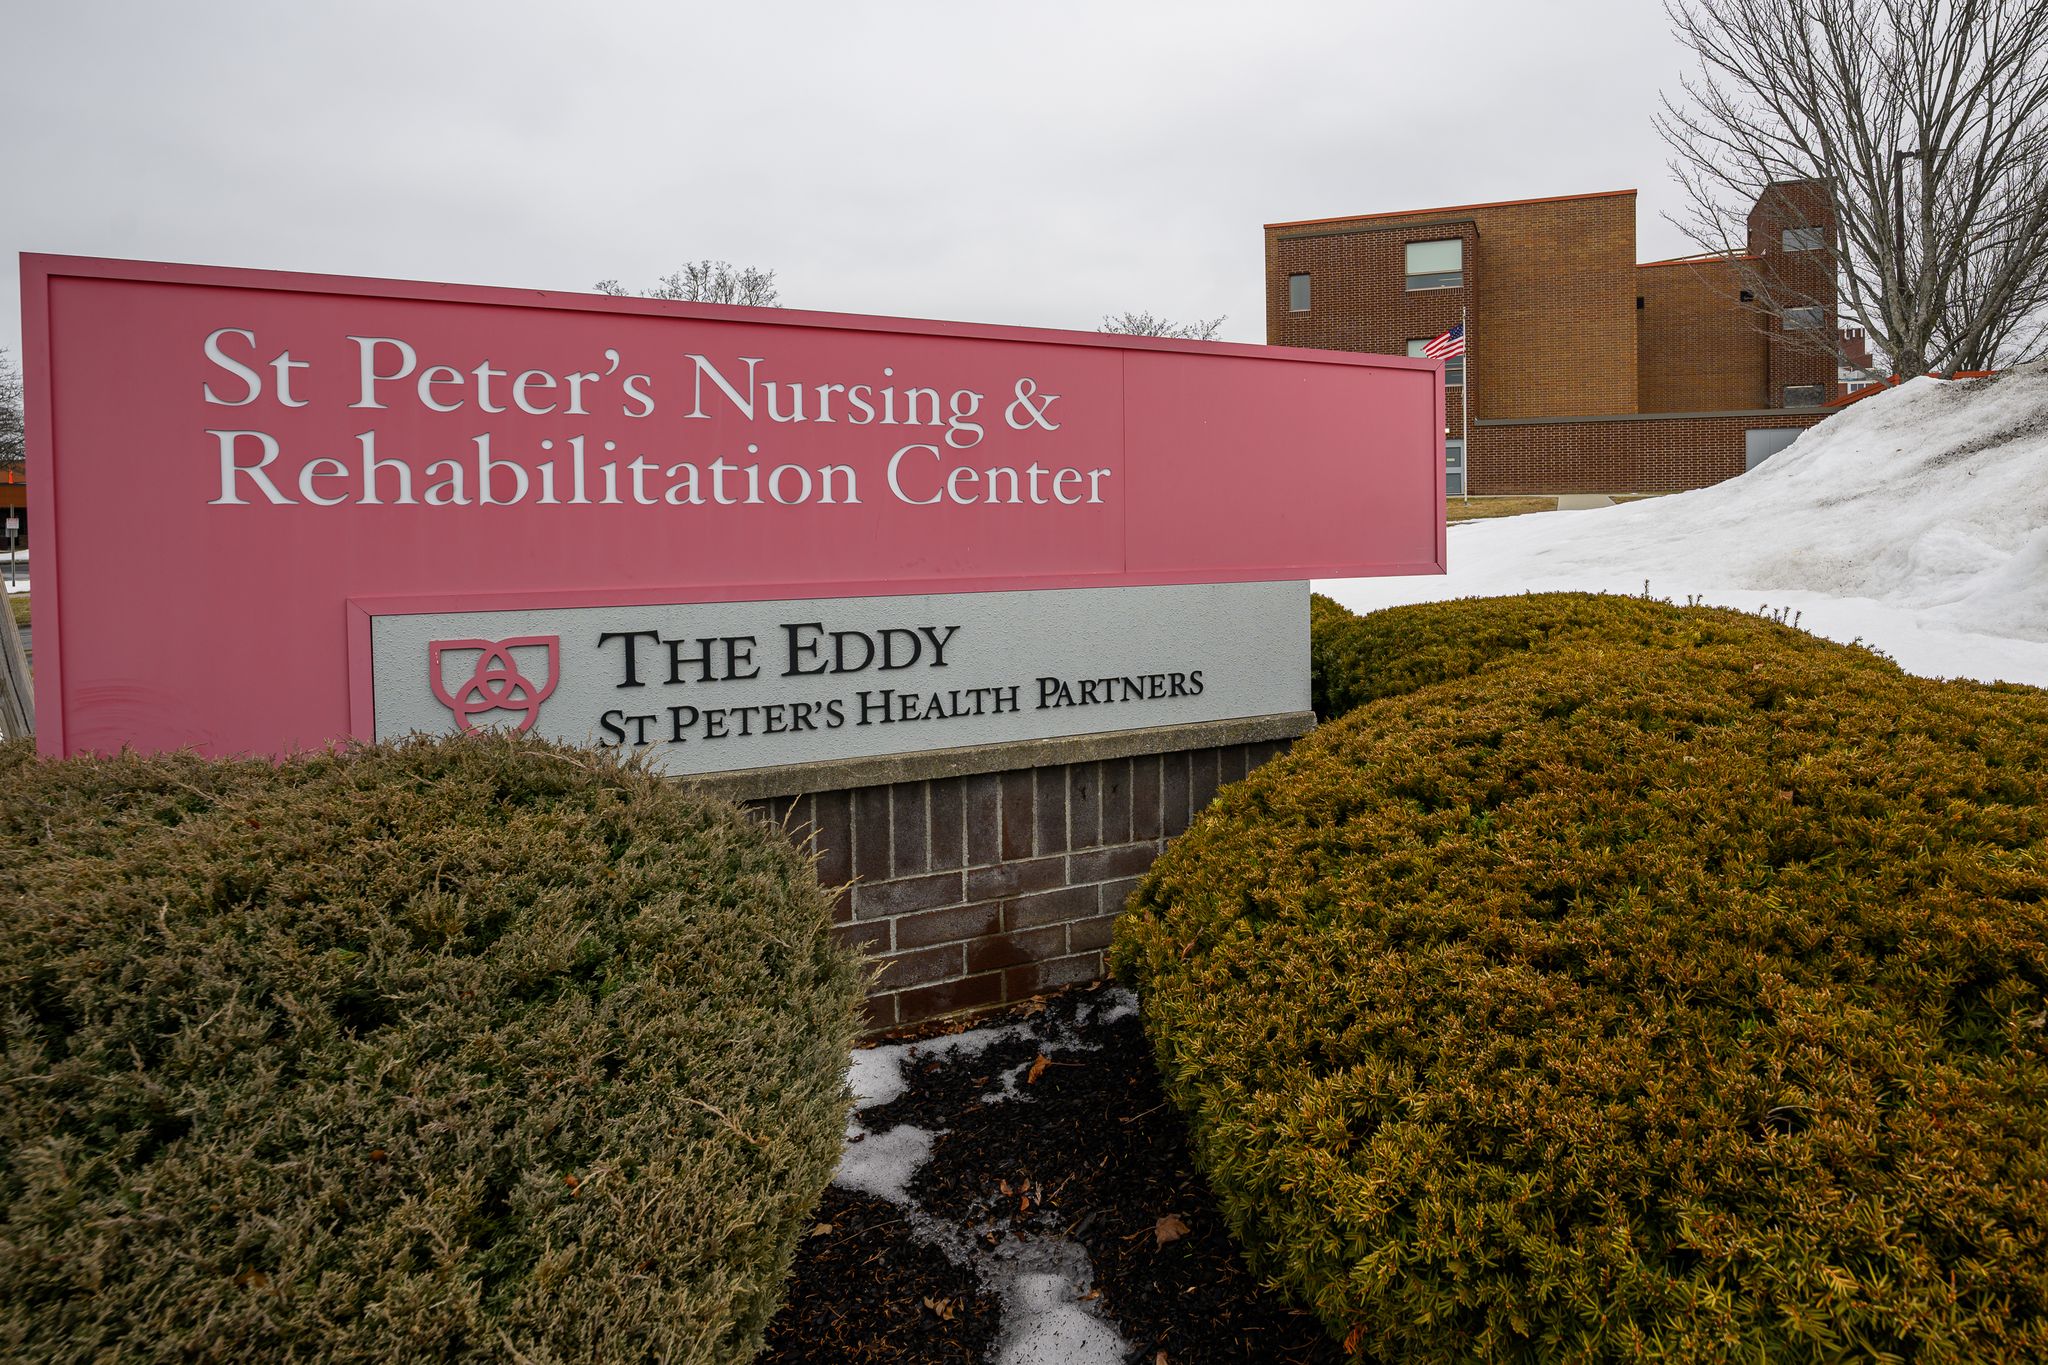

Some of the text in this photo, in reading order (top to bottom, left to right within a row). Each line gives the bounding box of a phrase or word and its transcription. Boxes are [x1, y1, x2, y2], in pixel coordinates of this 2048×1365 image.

[203, 328, 1061, 449] St Peter's Nursing &
[205, 430, 1112, 506] Rehabilitation Center
[597, 621, 962, 689] THE EDDY
[600, 670, 1205, 748] ST PETER'S HEALTH PARTNERS
